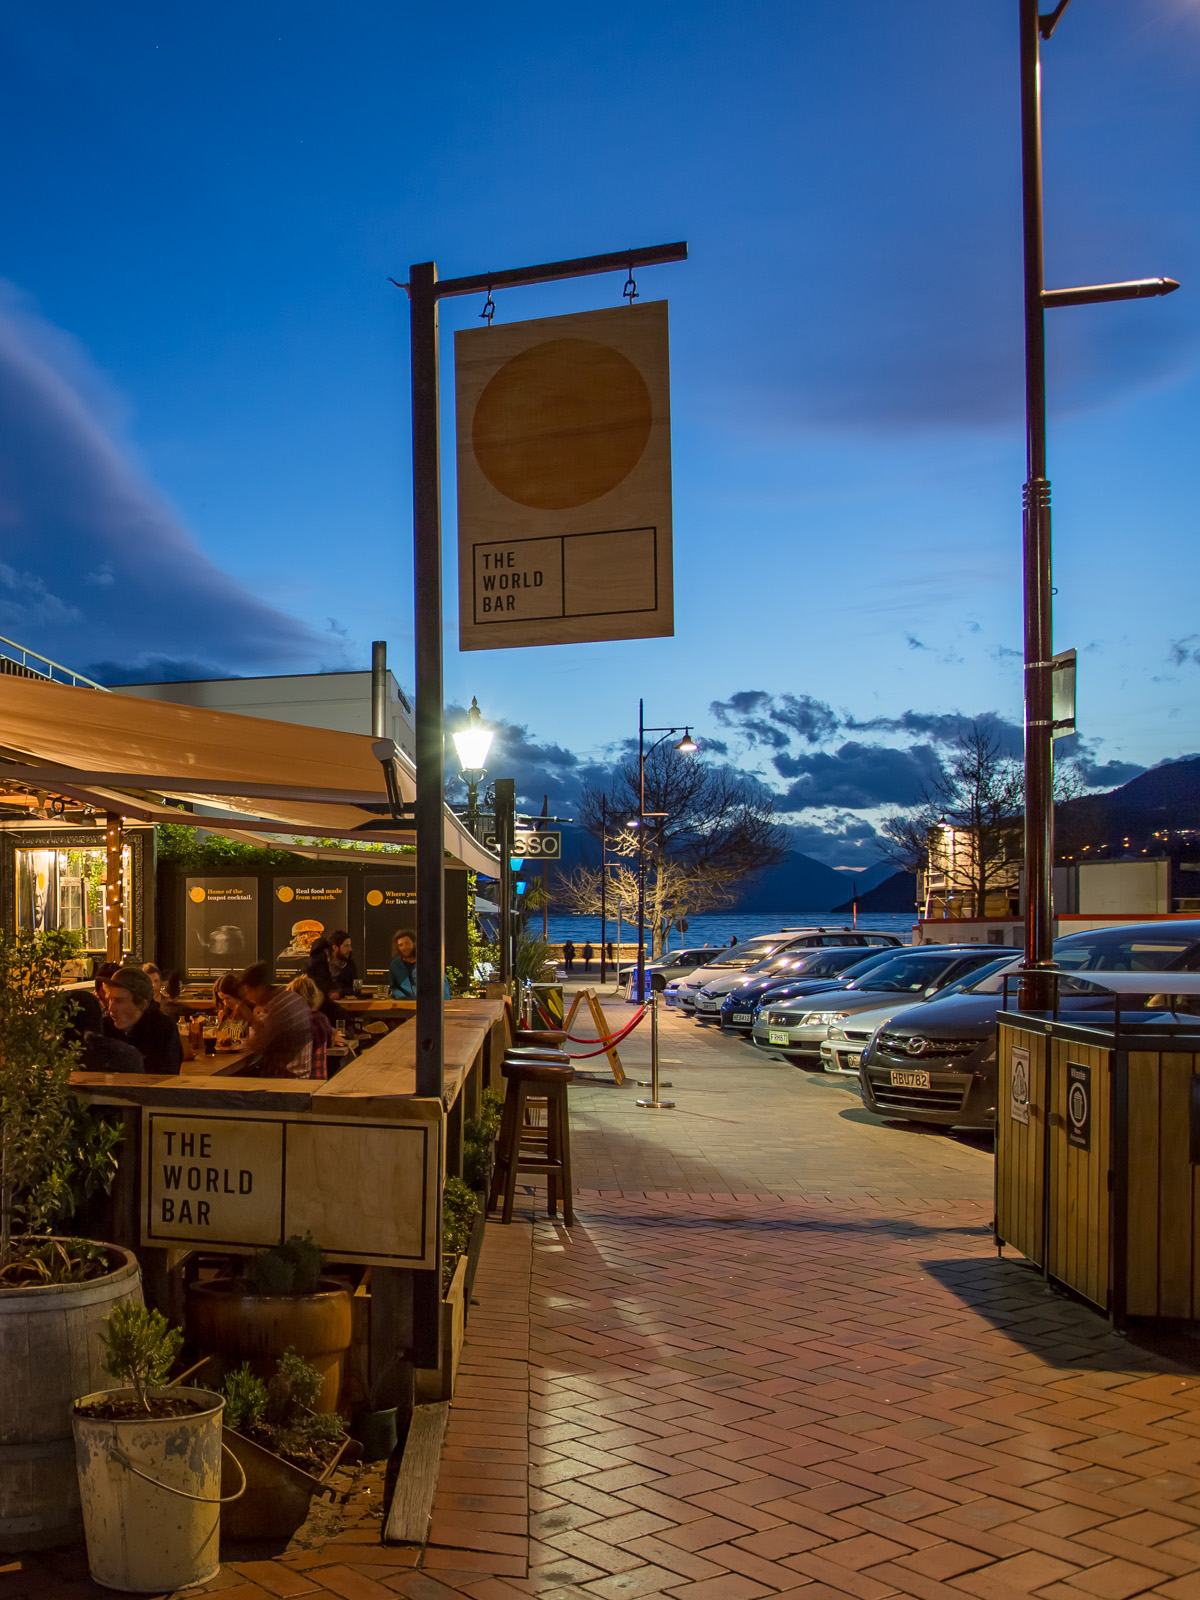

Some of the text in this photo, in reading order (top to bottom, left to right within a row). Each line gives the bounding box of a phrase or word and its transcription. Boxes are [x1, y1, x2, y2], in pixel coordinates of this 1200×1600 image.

[482, 551, 516, 570] THE
[483, 571, 543, 591] WORLD
[482, 594, 516, 613] BAR
[485, 836, 558, 854] SSSO
[892, 1072, 928, 1087] HBU782
[163, 1131, 212, 1159] THE
[163, 1165, 253, 1195] WORLD
[161, 1198, 211, 1226] BAR
